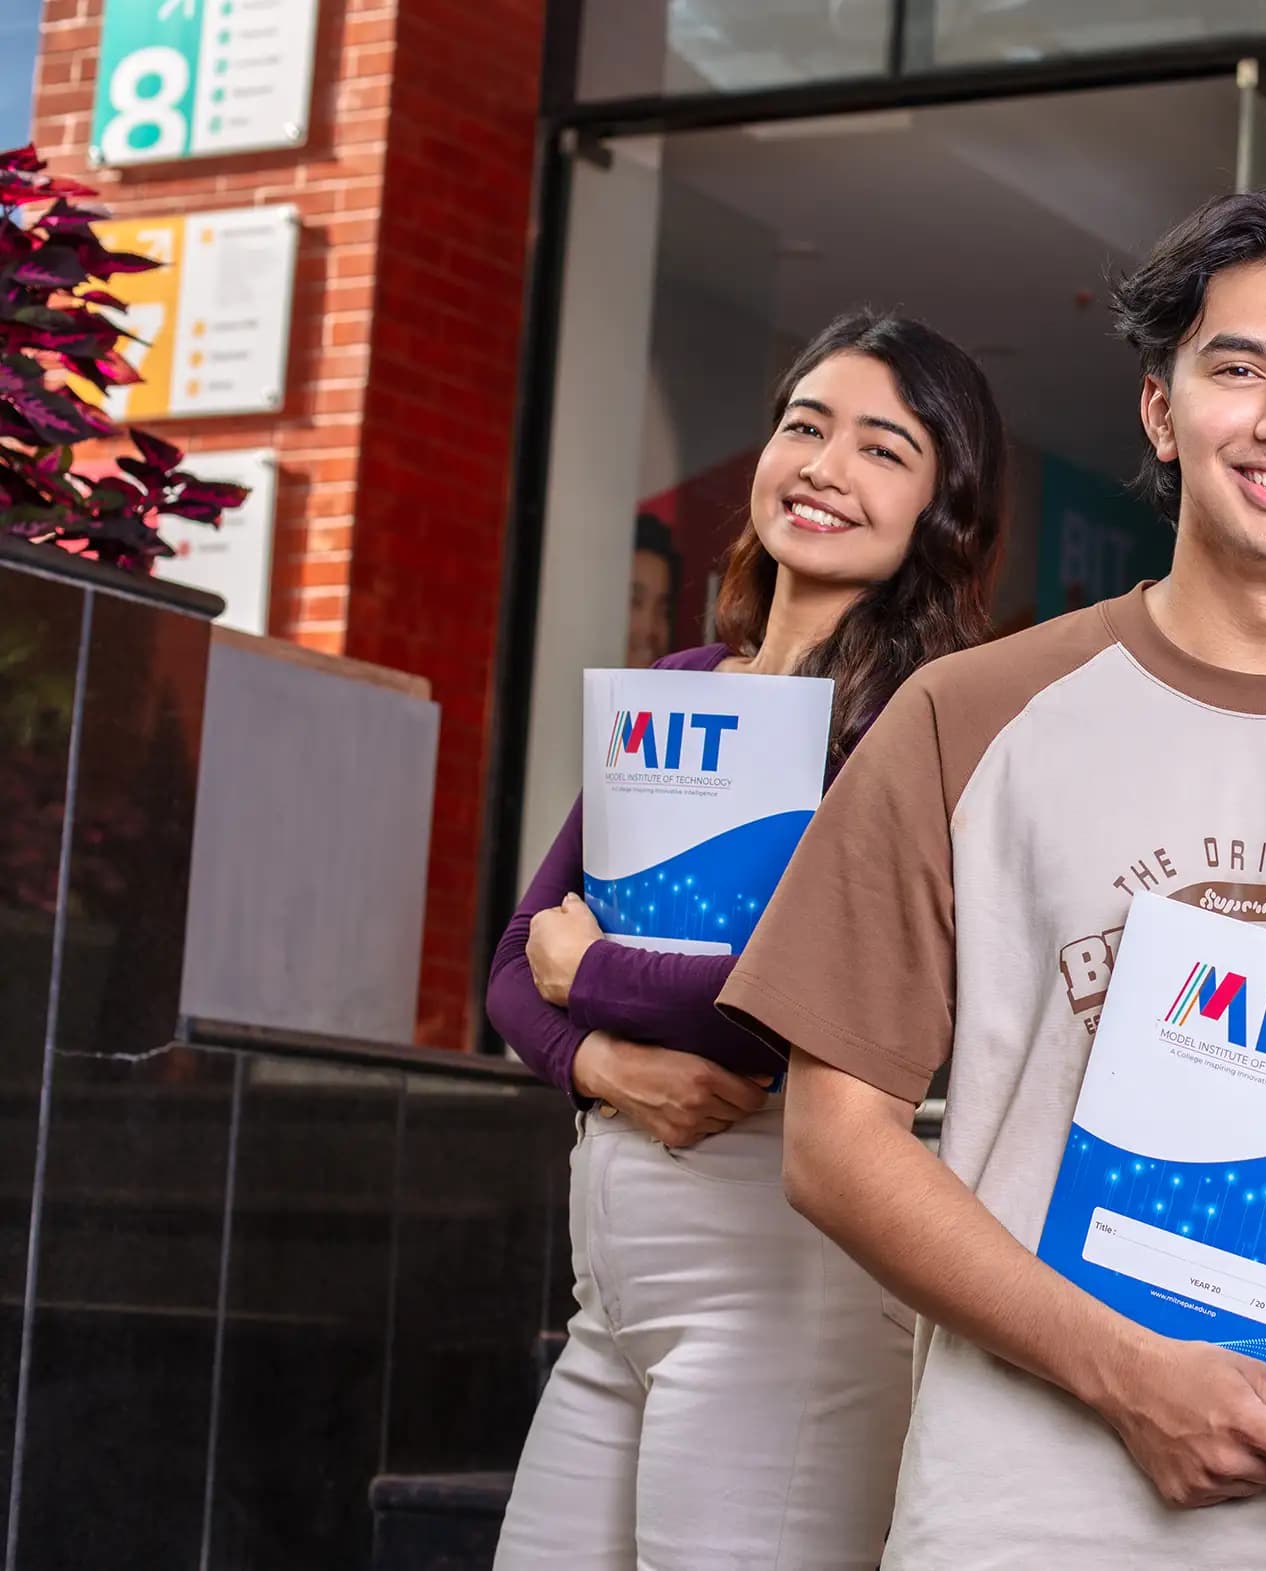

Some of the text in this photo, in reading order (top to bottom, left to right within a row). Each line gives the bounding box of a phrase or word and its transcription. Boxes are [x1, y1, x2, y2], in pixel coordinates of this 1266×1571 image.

[102, 46, 190, 156] 8
[606, 711, 739, 772] MIT
[627, 773, 662, 783] INSTITUTE
[662, 775, 674, 783] OF
[675, 775, 733, 787] TECHNOLOGY
[1113, 848, 1177, 896] THE
[1160, 1029, 1195, 1048] MODEL
[1198, 1041, 1249, 1066] INSTITUTE
[1250, 1058, 1266, 1070] OF
[1176, 1050, 1204, 1064] College
[1204, 1060, 1237, 1076] Inspiring
[1189, 1277, 1222, 1294] YEAR 20
[1150, 1289, 1217, 1319] www.mitnepal.edu.np
